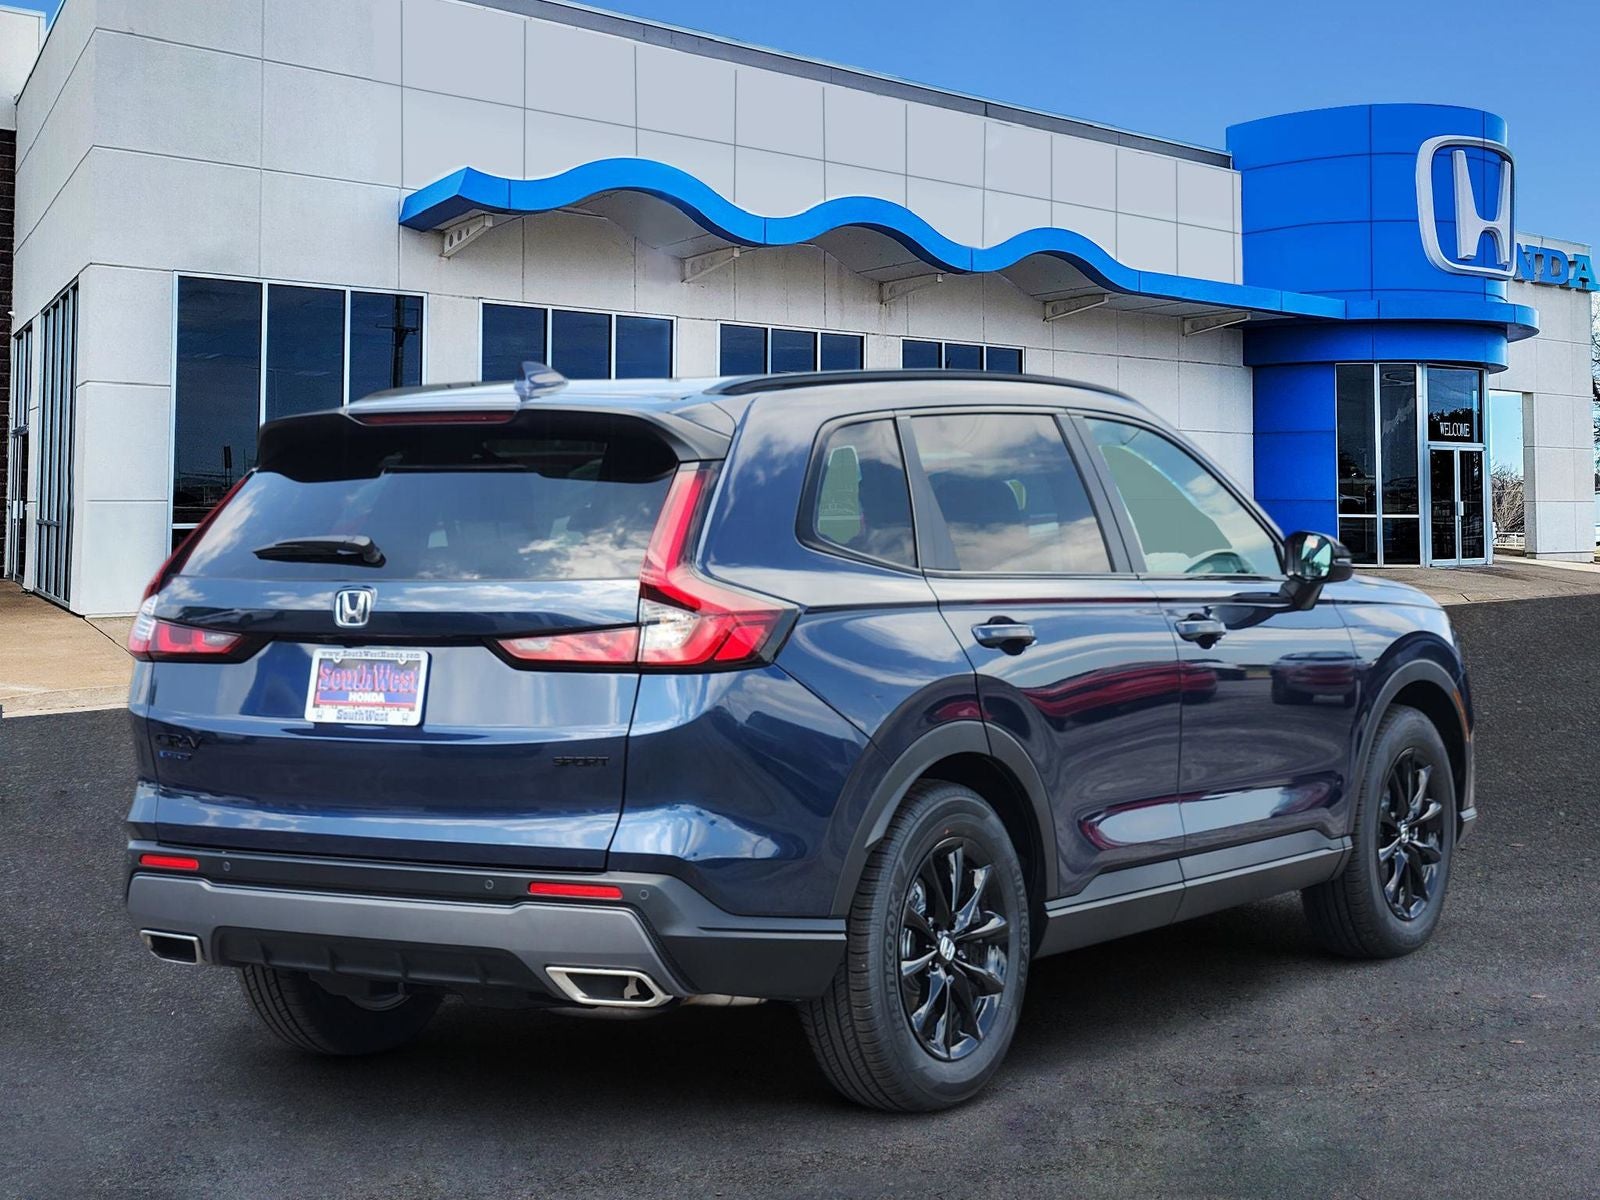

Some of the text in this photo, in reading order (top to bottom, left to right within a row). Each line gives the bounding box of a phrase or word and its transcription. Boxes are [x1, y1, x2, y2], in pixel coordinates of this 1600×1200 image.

[1440, 422, 1470, 437] WELCOME
[318, 663, 419, 693] SouthWest
[347, 691, 385, 703] HONDA
[336, 709, 389, 722] SouthWest
[552, 756, 609, 767] SPORT
